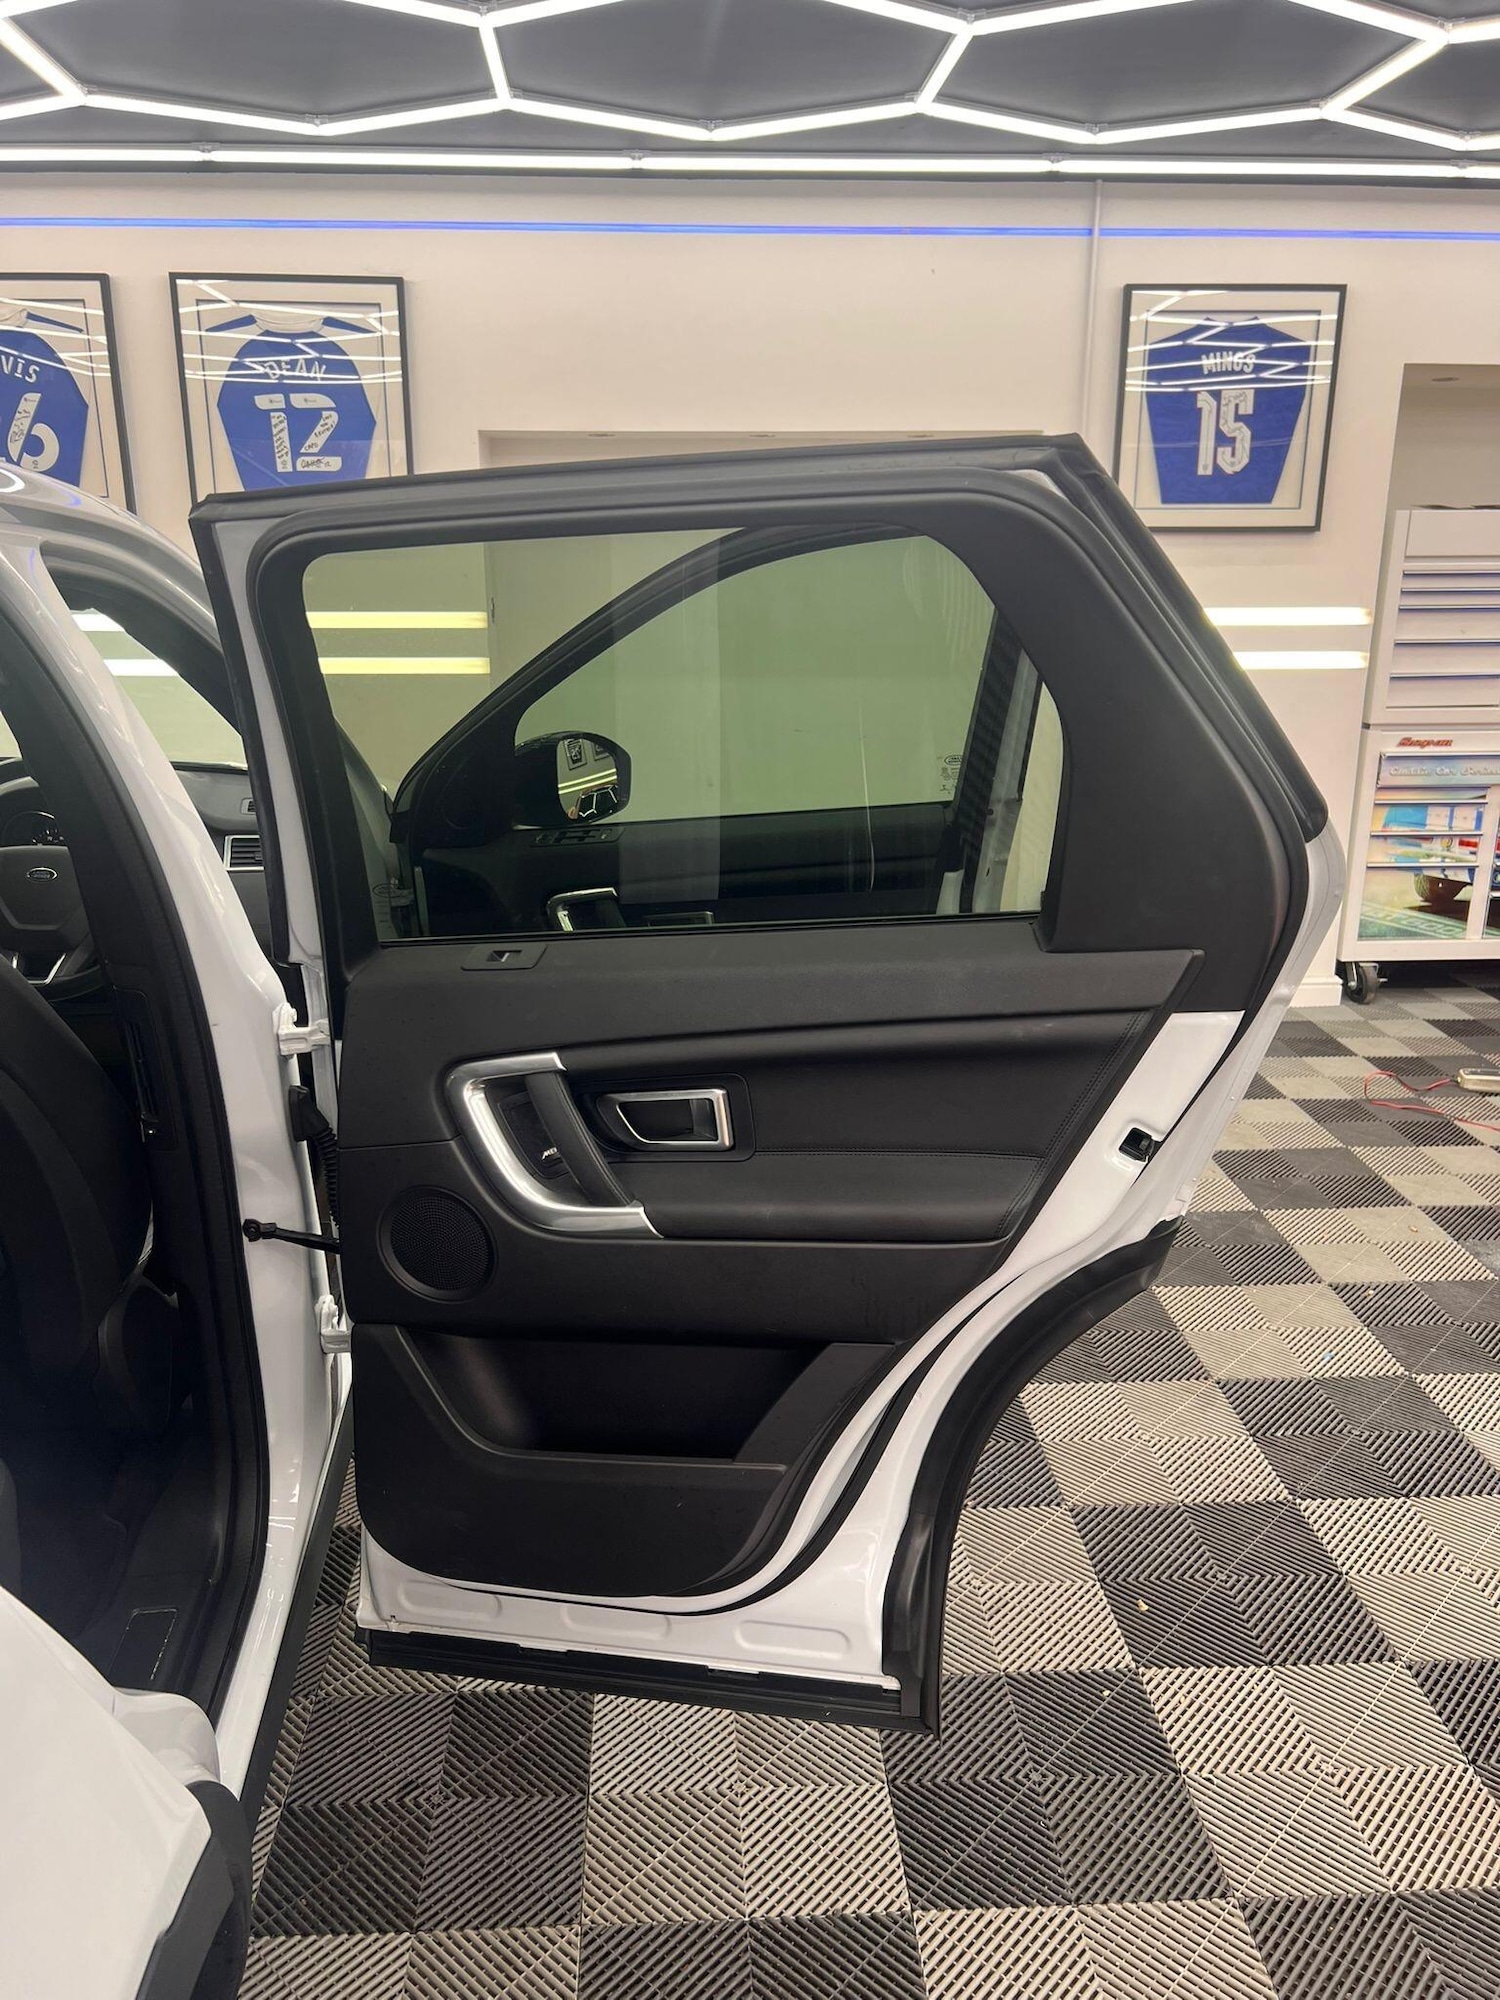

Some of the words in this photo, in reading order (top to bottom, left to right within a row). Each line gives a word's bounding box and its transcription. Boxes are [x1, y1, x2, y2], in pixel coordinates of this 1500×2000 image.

[263, 358, 327, 382] DEAN
[1201, 351, 1256, 375] MINGS
[0, 392, 60, 472] 6
[254, 393, 342, 473] 12
[1196, 388, 1255, 475] 15
